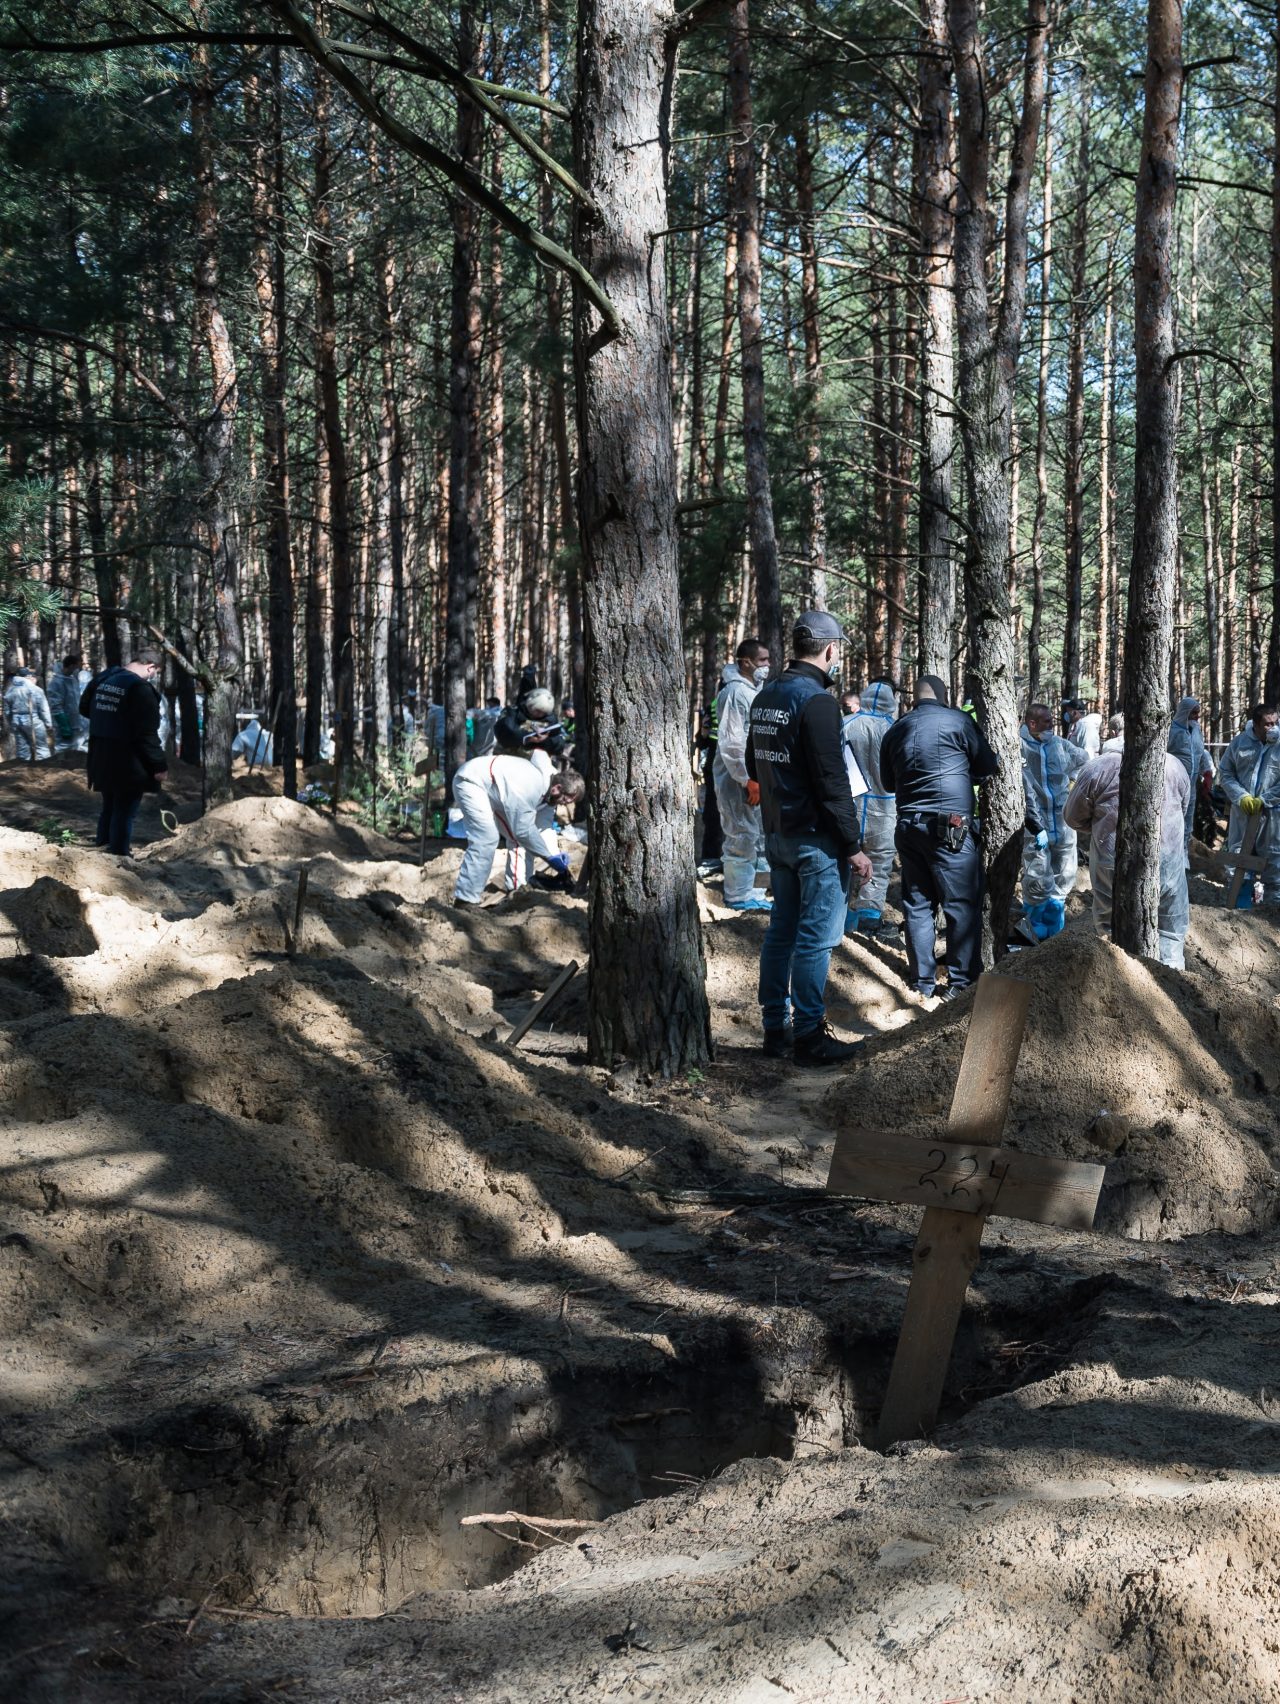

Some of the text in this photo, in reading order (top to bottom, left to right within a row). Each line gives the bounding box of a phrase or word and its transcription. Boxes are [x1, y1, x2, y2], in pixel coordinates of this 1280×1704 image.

[104, 684, 125, 696] CRIMES
[762, 708, 790, 725] CRIMES
[764, 750, 791, 764] REGION
[918, 1148, 1010, 1203] 224
